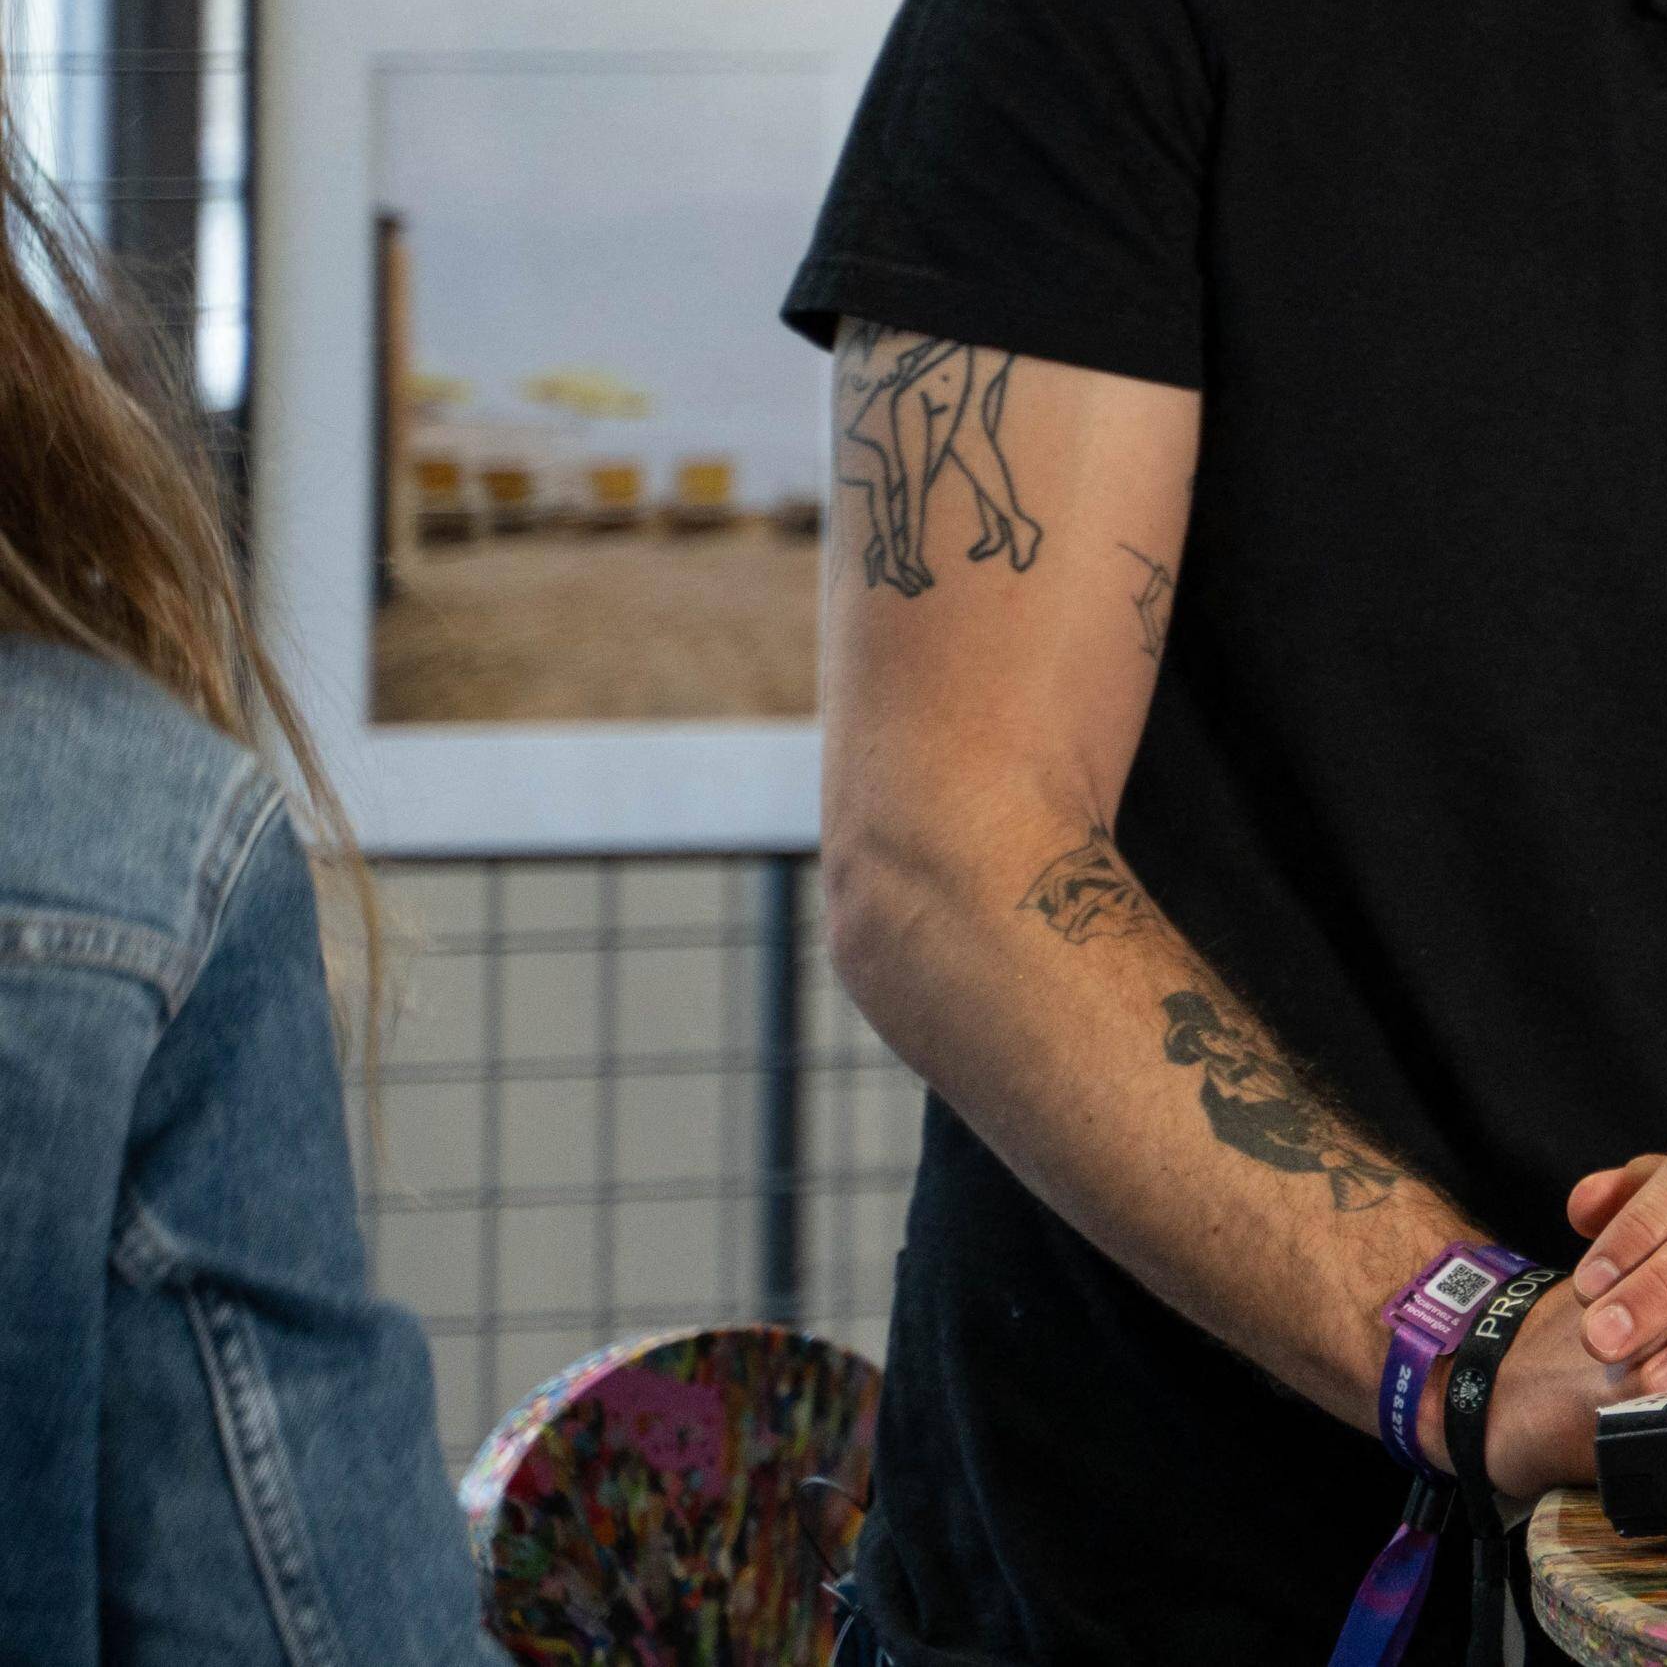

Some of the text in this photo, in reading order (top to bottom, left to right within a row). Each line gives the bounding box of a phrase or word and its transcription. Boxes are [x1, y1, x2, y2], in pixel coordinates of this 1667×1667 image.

[1475, 1269, 1568, 1339] PROD
[1396, 1364, 1412, 1394] 26
[1392, 1395, 1405, 1410] &
